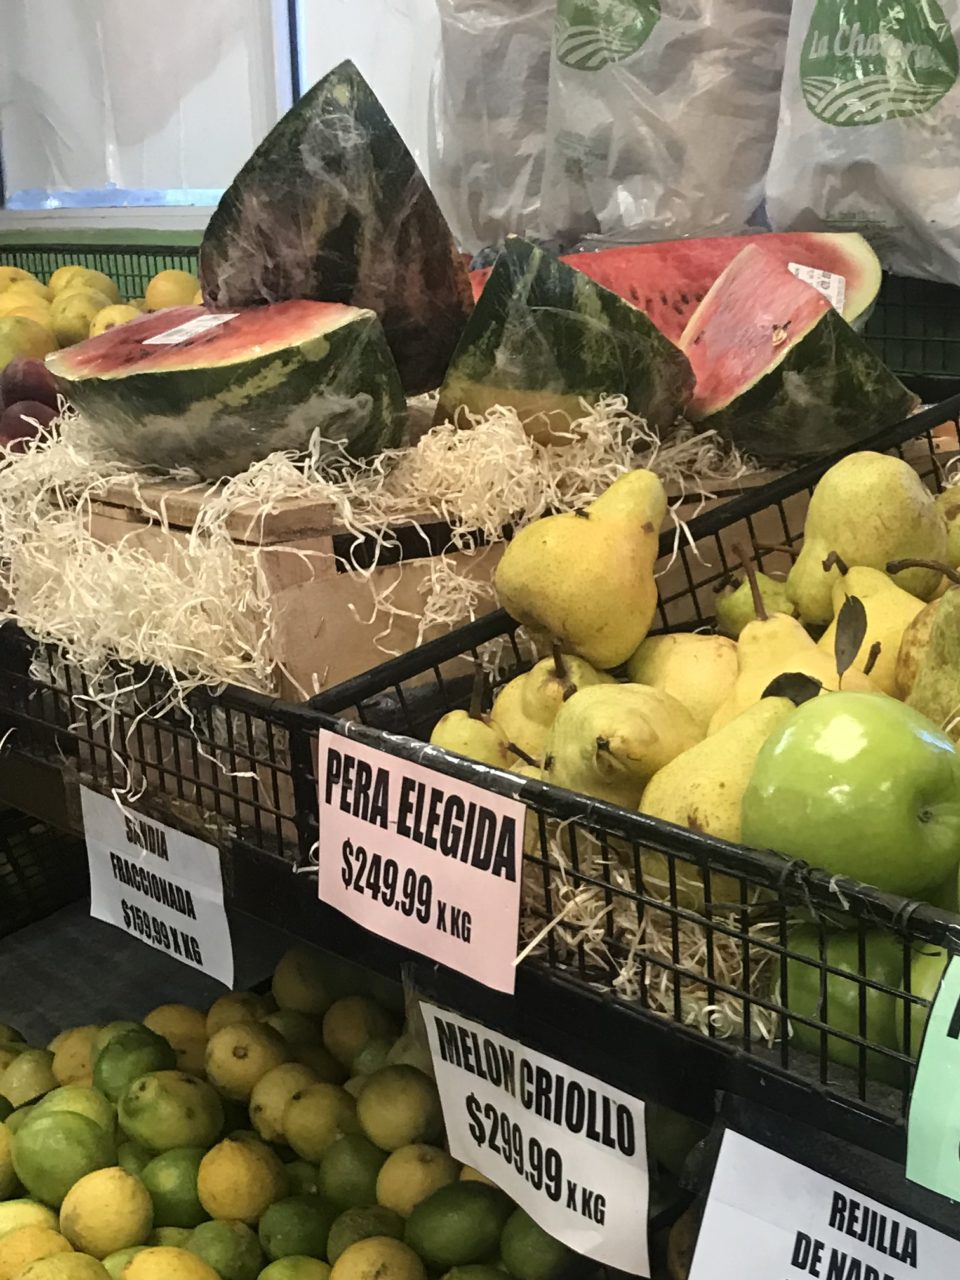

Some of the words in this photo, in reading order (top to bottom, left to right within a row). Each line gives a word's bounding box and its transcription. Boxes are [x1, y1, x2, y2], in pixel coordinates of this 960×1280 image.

[325, 747, 389, 830] PERA
[396, 774, 517, 882] ELEGIDA
[110, 851, 197, 920] FRACCIONADA
[121, 898, 171, 950] $159,99
[169, 925, 182, 956] X
[181, 932, 203, 966] KG
[342, 836, 432, 925] $249.99
[436, 900, 448, 932] X
[451, 907, 472, 944] KG
[434, 1016, 516, 1098] MELON
[520, 1058, 636, 1157] CRIOLLO
[466, 1092, 563, 1202] $299.99
[566, 1179, 578, 1212] X
[582, 1187, 606, 1226] KG
[791, 1230, 825, 1278] DE
[828, 1190, 918, 1269] REJILLA
